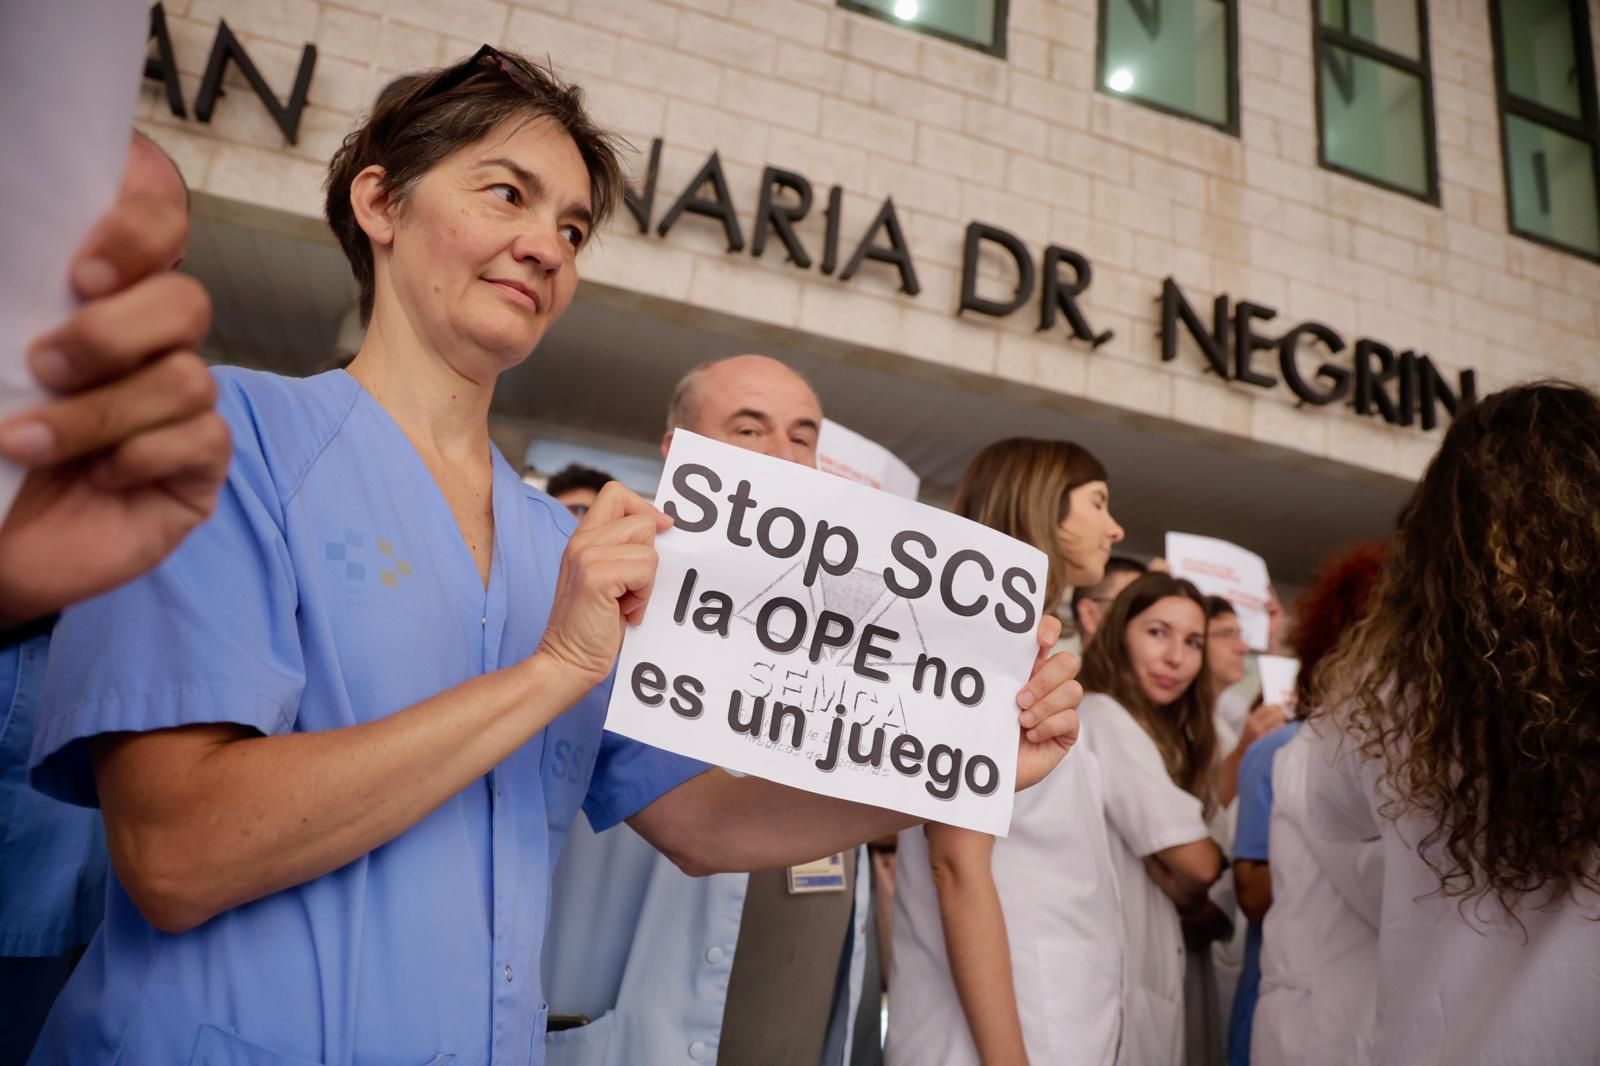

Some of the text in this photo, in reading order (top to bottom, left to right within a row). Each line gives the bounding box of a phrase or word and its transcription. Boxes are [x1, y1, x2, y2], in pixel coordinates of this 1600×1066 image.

[1155, 276, 1478, 432] NEGRIN
[664, 463, 1037, 634] Stop SCS
[673, 568, 985, 706] la OPE no
[631, 661, 705, 719] es
[728, 690, 806, 749] un
[815, 703, 999, 801] juego
